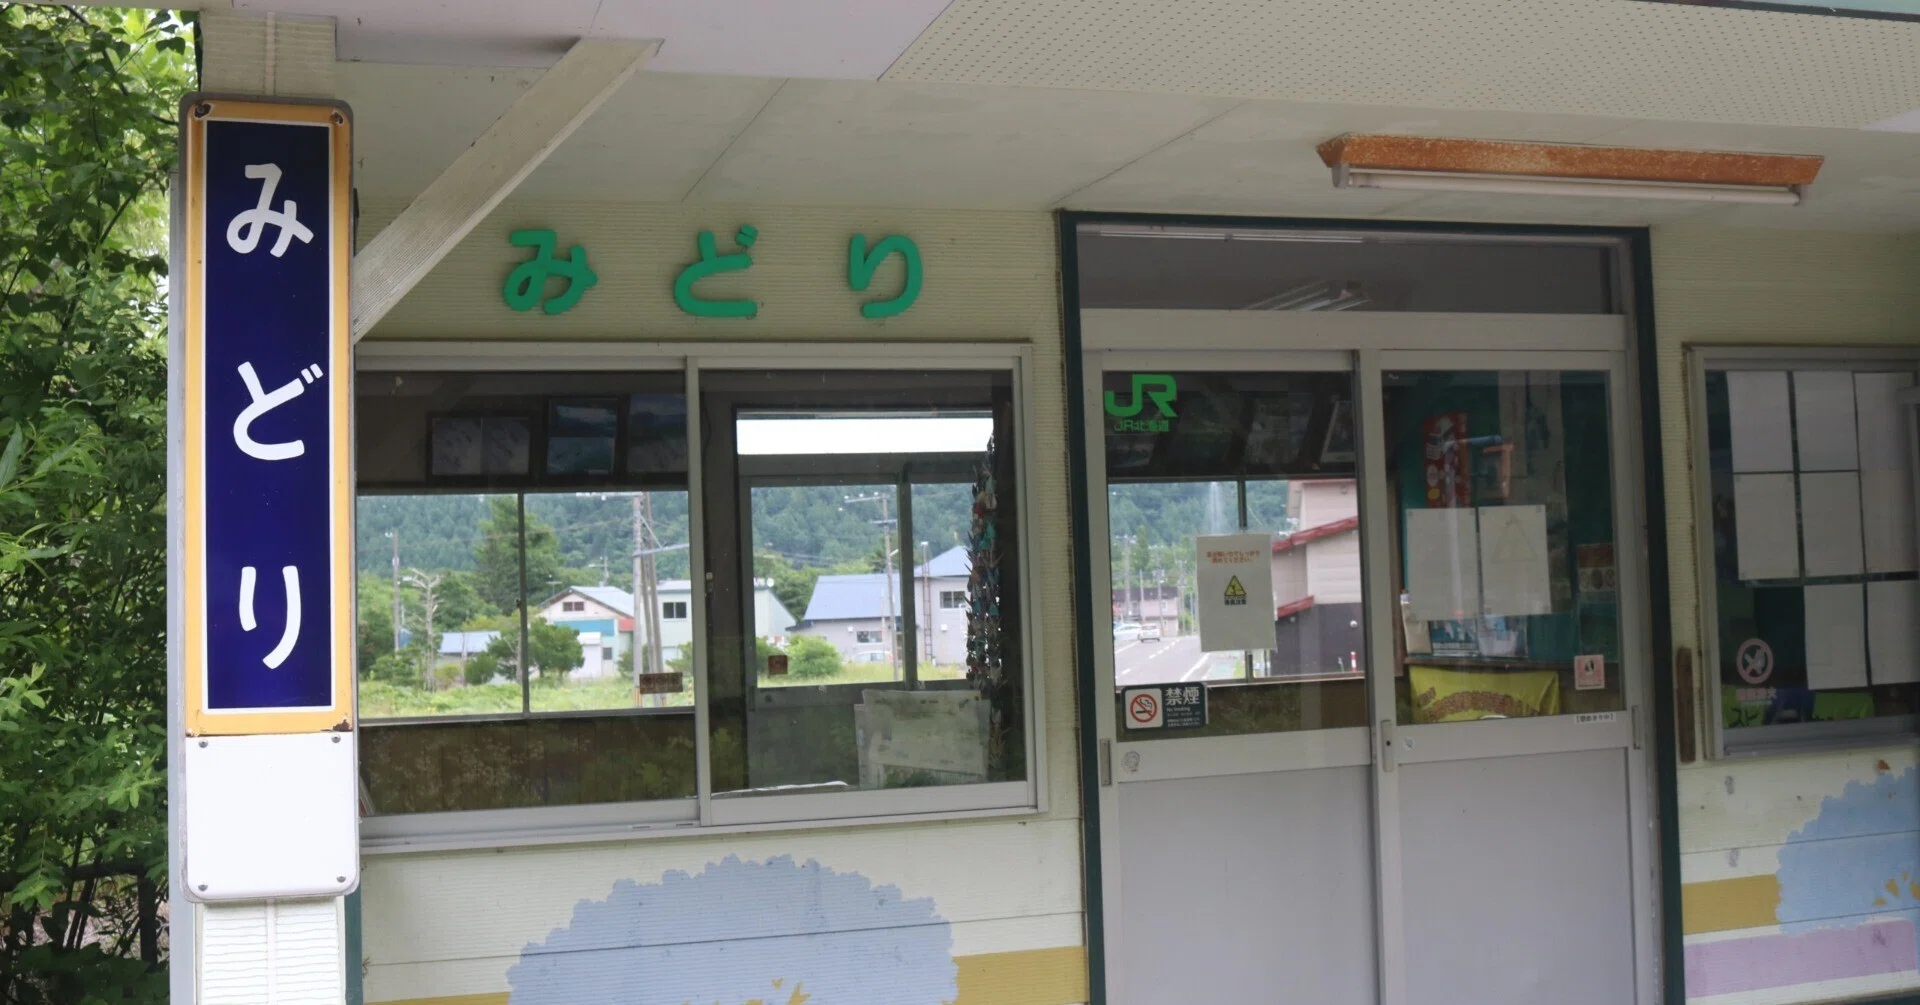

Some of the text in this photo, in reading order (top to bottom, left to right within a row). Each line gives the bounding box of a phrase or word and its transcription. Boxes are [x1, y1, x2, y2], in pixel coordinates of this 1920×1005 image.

[503, 225, 923, 318] みどり
[226, 163, 324, 669] みどり
[1104, 374, 1178, 417] JR
[1114, 420, 1170, 433] JR北海道
[1165, 686, 1201, 706] 禁煙
